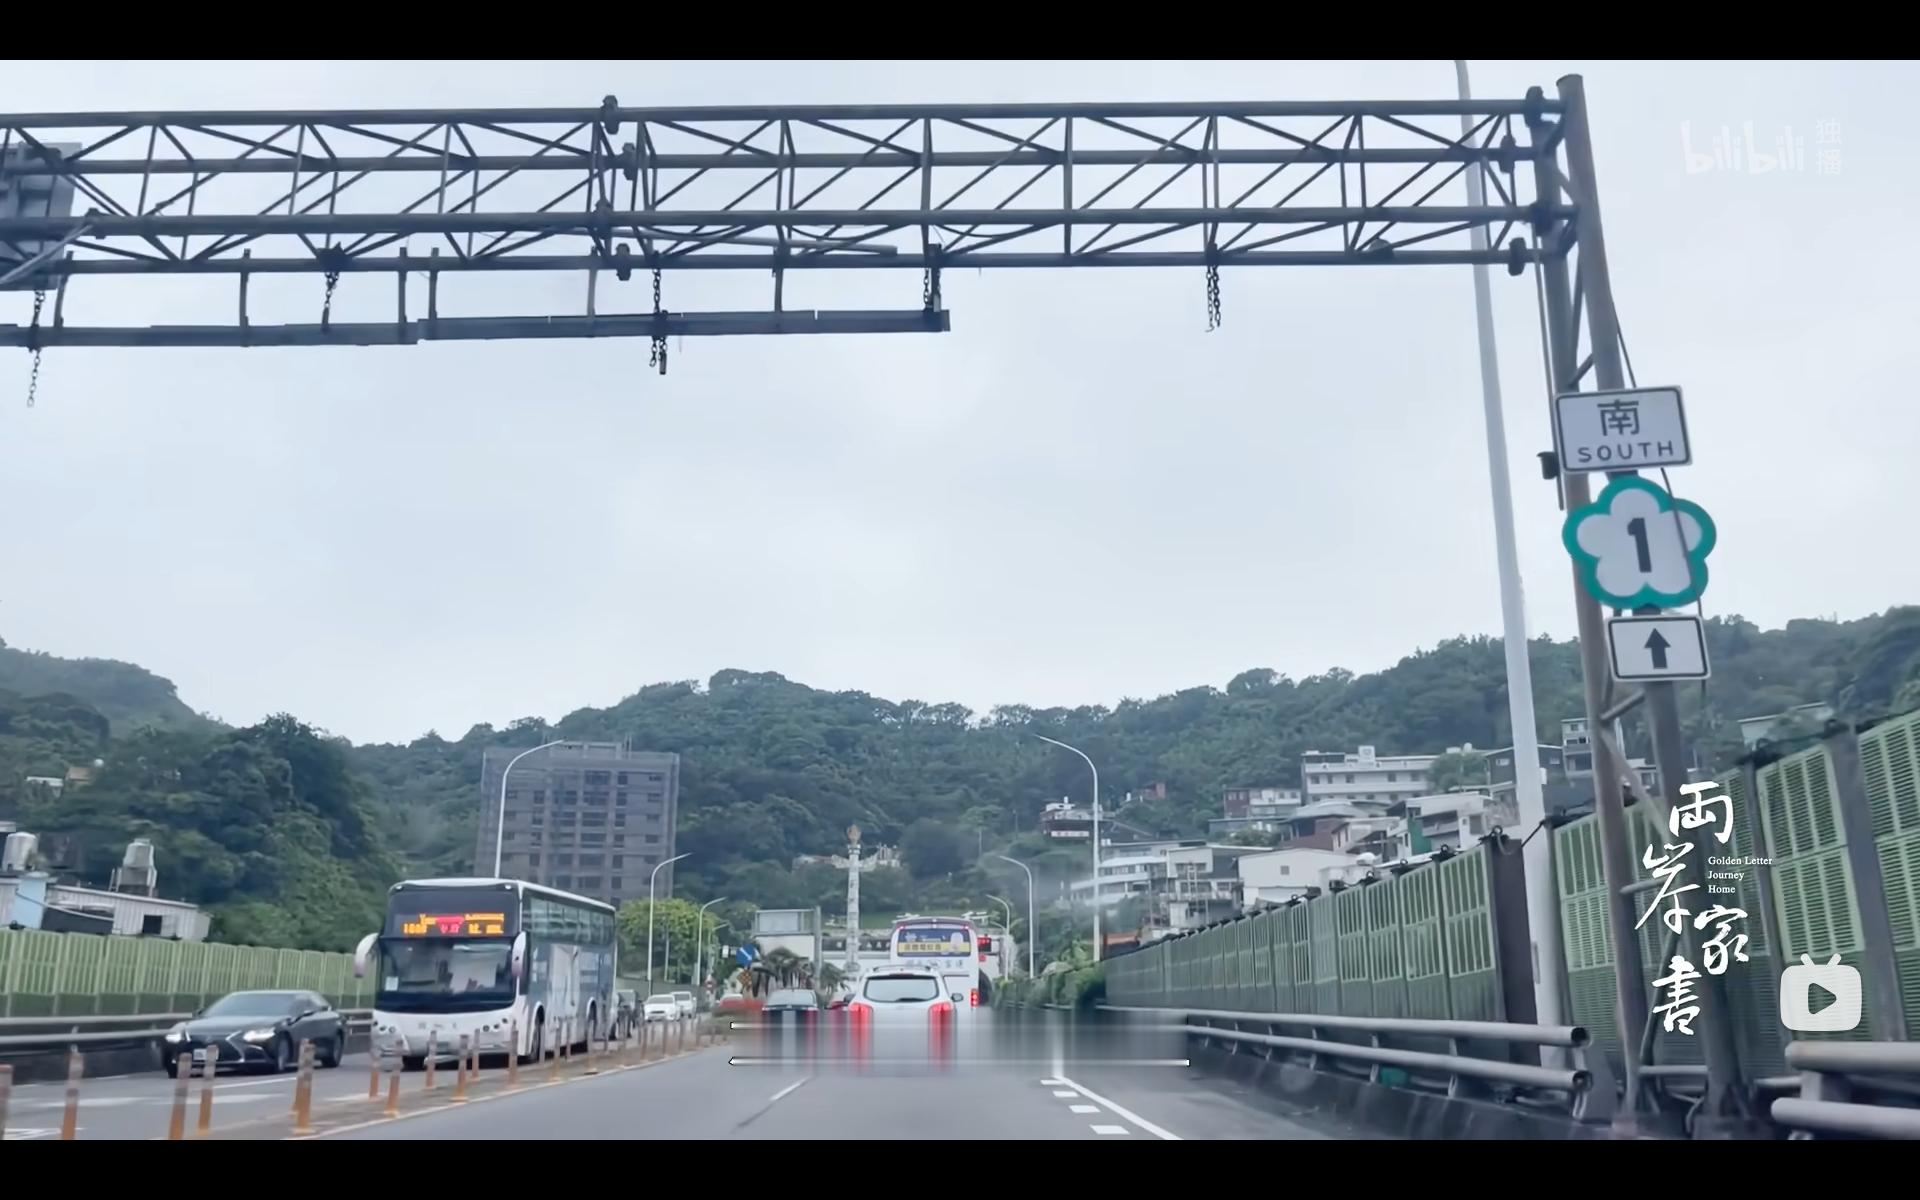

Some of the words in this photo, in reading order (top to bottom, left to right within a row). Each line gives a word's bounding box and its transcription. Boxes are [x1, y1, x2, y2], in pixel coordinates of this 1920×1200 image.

[1597, 399, 1641, 437] 南
[1577, 440, 1674, 464] SOUTH
[1626, 517, 1653, 573] 1
